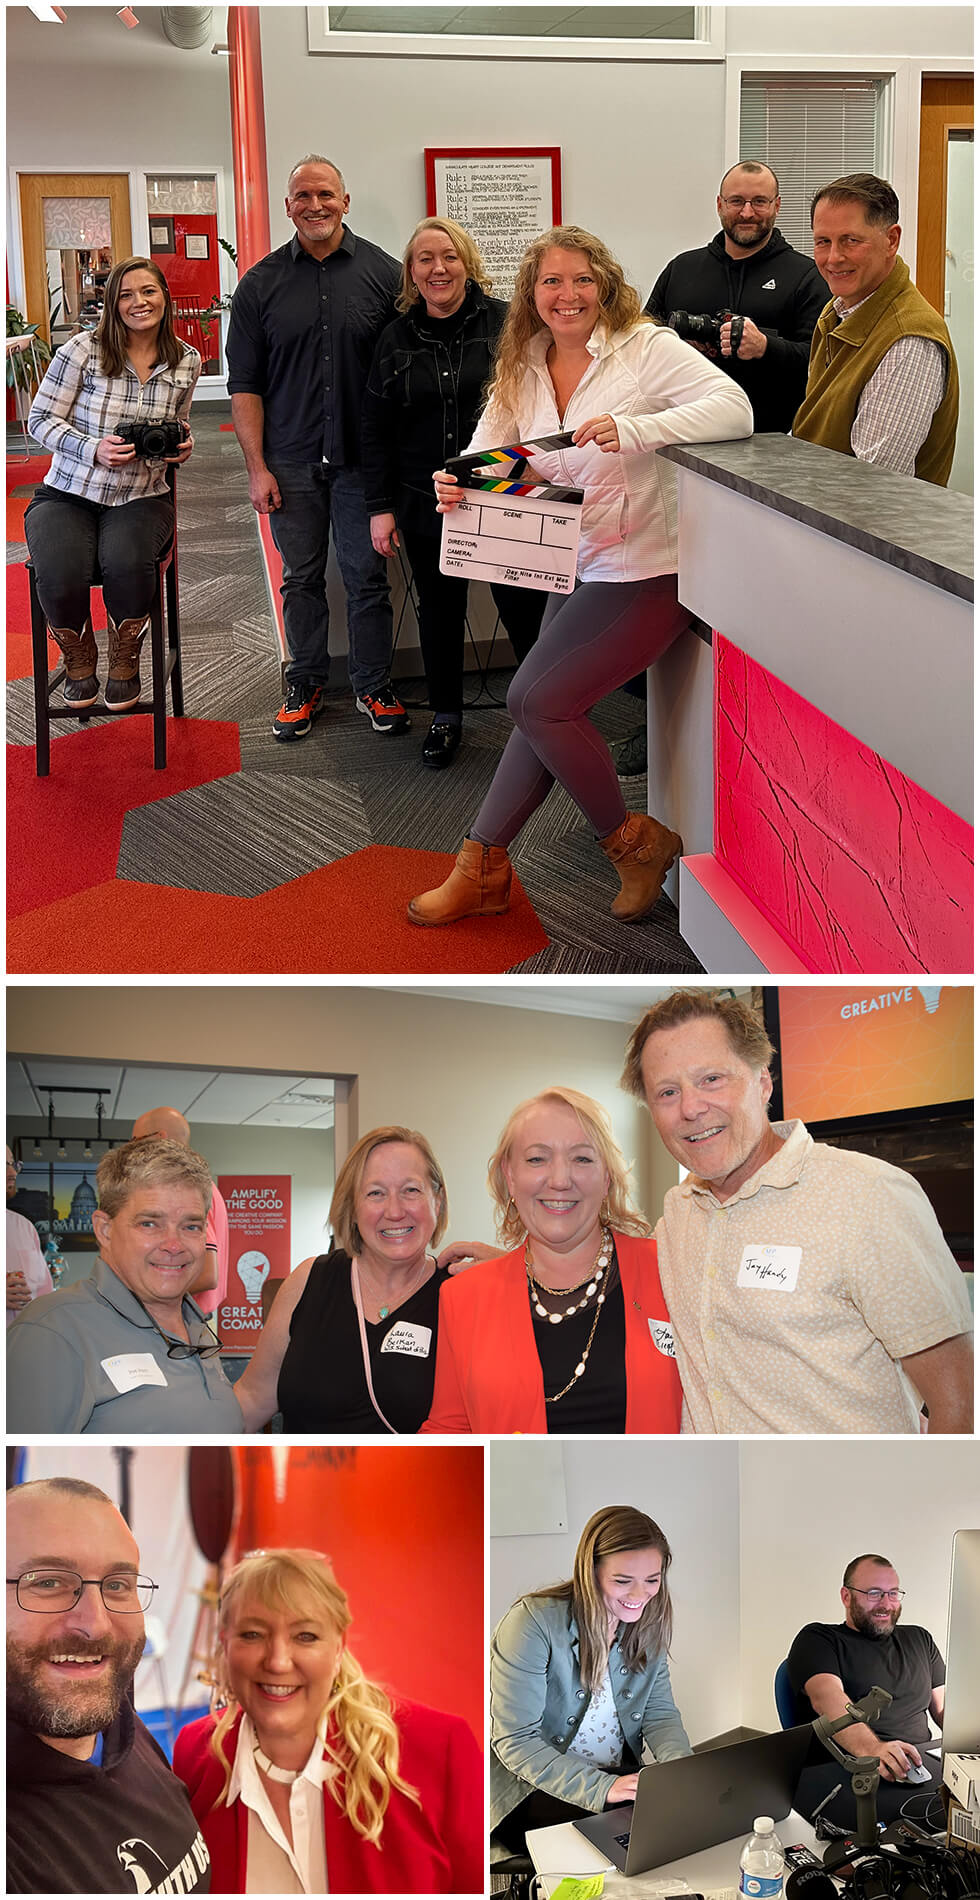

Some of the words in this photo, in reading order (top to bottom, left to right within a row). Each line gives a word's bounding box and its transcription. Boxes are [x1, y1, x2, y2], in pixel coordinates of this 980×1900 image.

[446, 173, 463, 182] Rule
[446, 182, 463, 191] Rule
[447, 194, 463, 202] Rule
[448, 203, 463, 212] Rule
[448, 212, 463, 220] Rule
[504, 237, 516, 245] rule
[503, 511, 522, 519] SCENE
[448, 538, 477, 548] DIRECTOR:
[447, 548, 472, 557] CAMERA:
[840, 986, 913, 1019] CREATIVE
[231, 1188, 277, 1199] AMPLIFY
[225, 1200, 246, 1209] THE
[249, 1200, 283, 1209] GOOD
[746, 1258, 761, 1274] Jay
[190, 1831, 210, 1874] US
